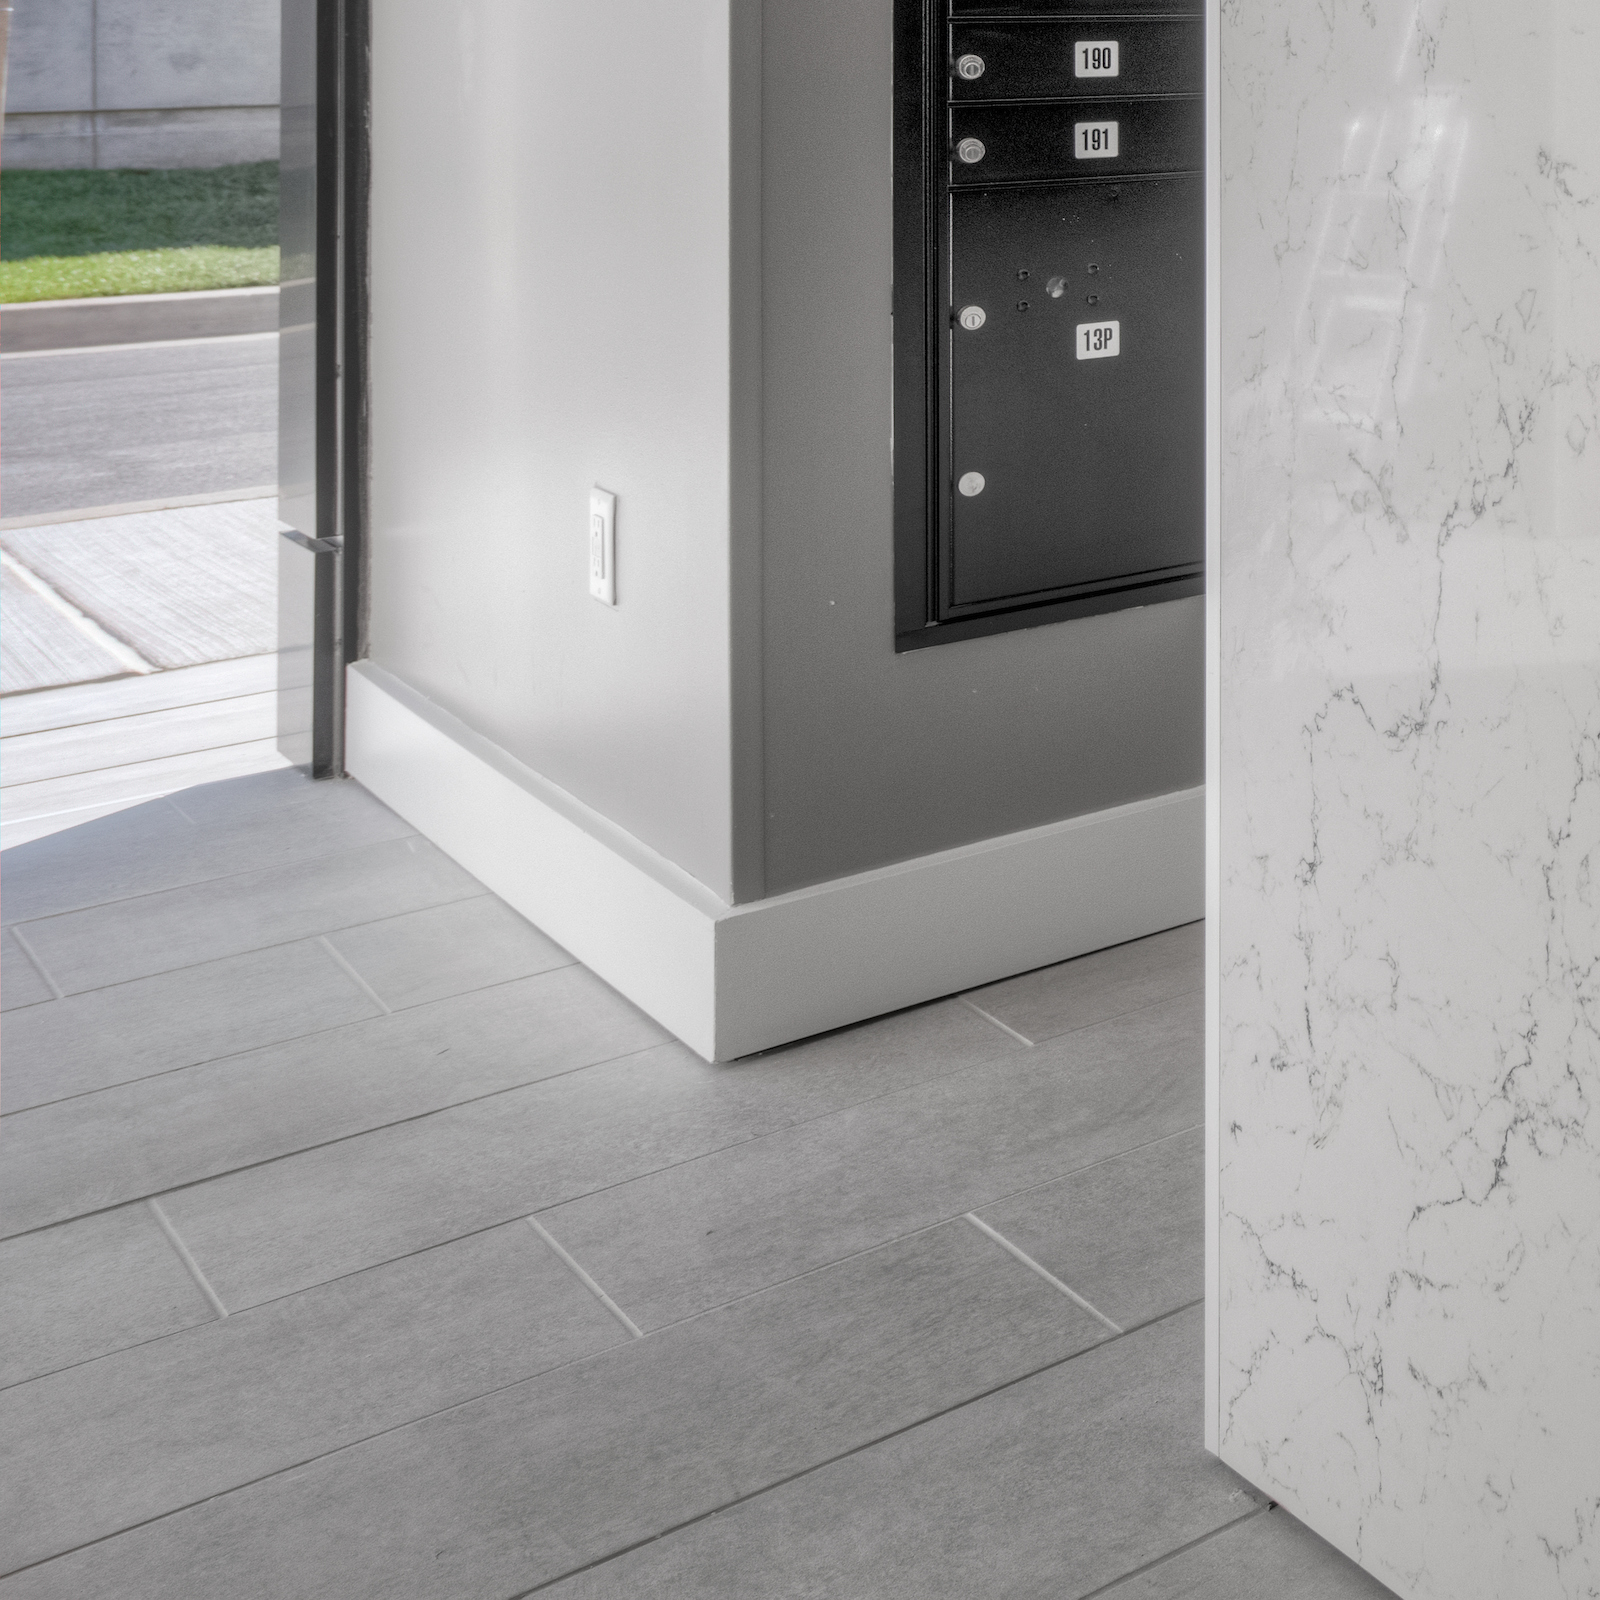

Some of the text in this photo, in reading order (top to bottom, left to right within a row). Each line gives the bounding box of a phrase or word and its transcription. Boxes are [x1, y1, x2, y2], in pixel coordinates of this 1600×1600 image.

[1082, 47, 1112, 70] 190
[1082, 128, 1110, 151] 191
[1083, 328, 1114, 353] 13P
